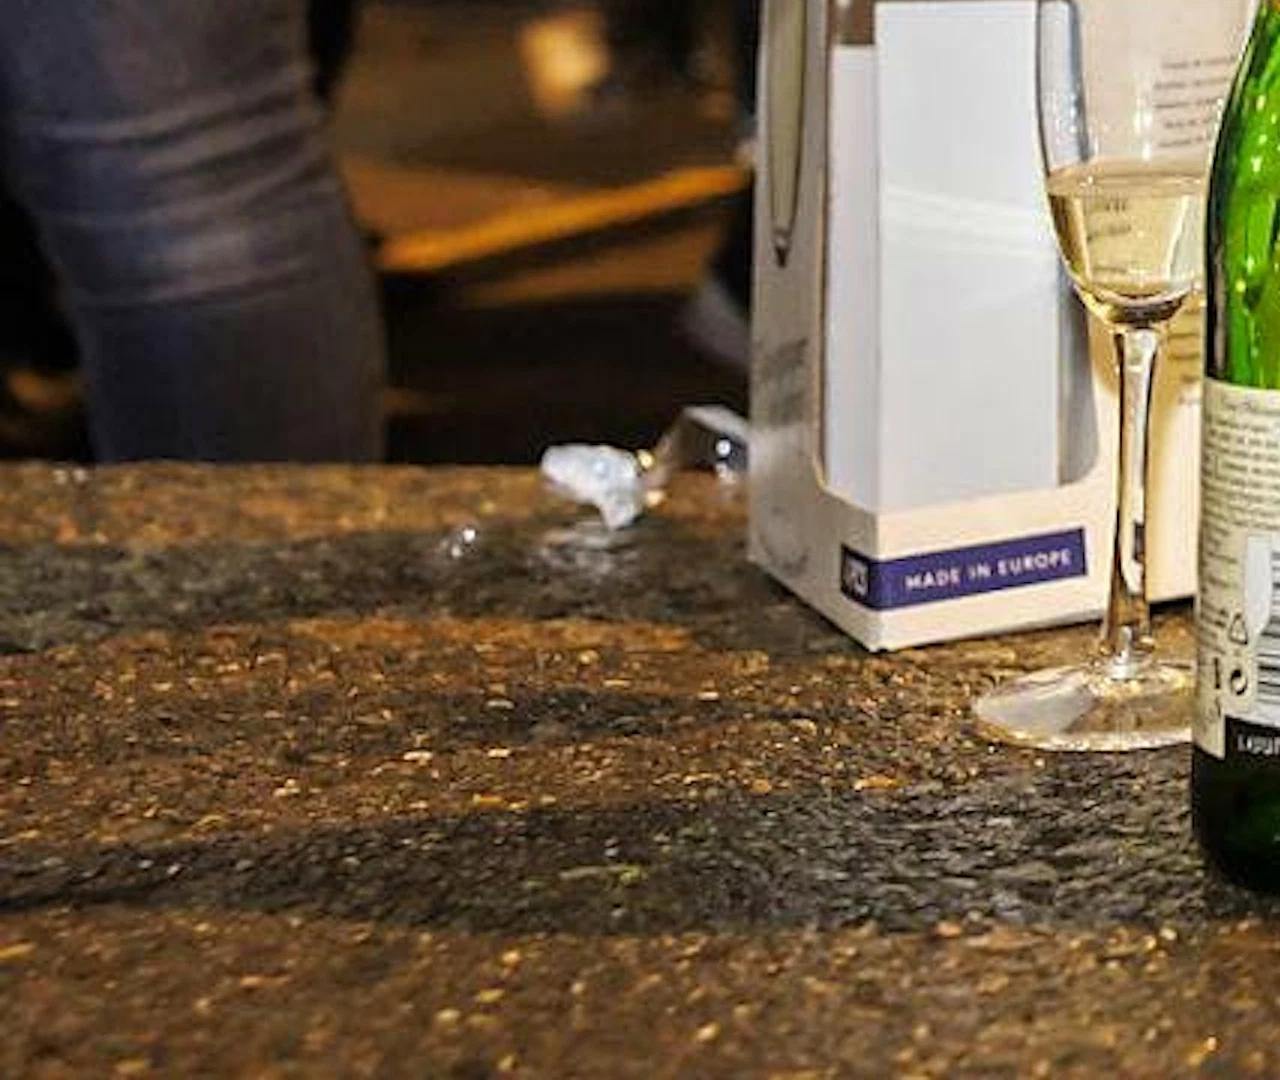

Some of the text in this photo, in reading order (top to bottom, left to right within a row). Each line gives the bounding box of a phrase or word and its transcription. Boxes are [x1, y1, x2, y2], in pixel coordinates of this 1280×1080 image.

[904, 548, 1073, 590] MADE IN EUROPE
